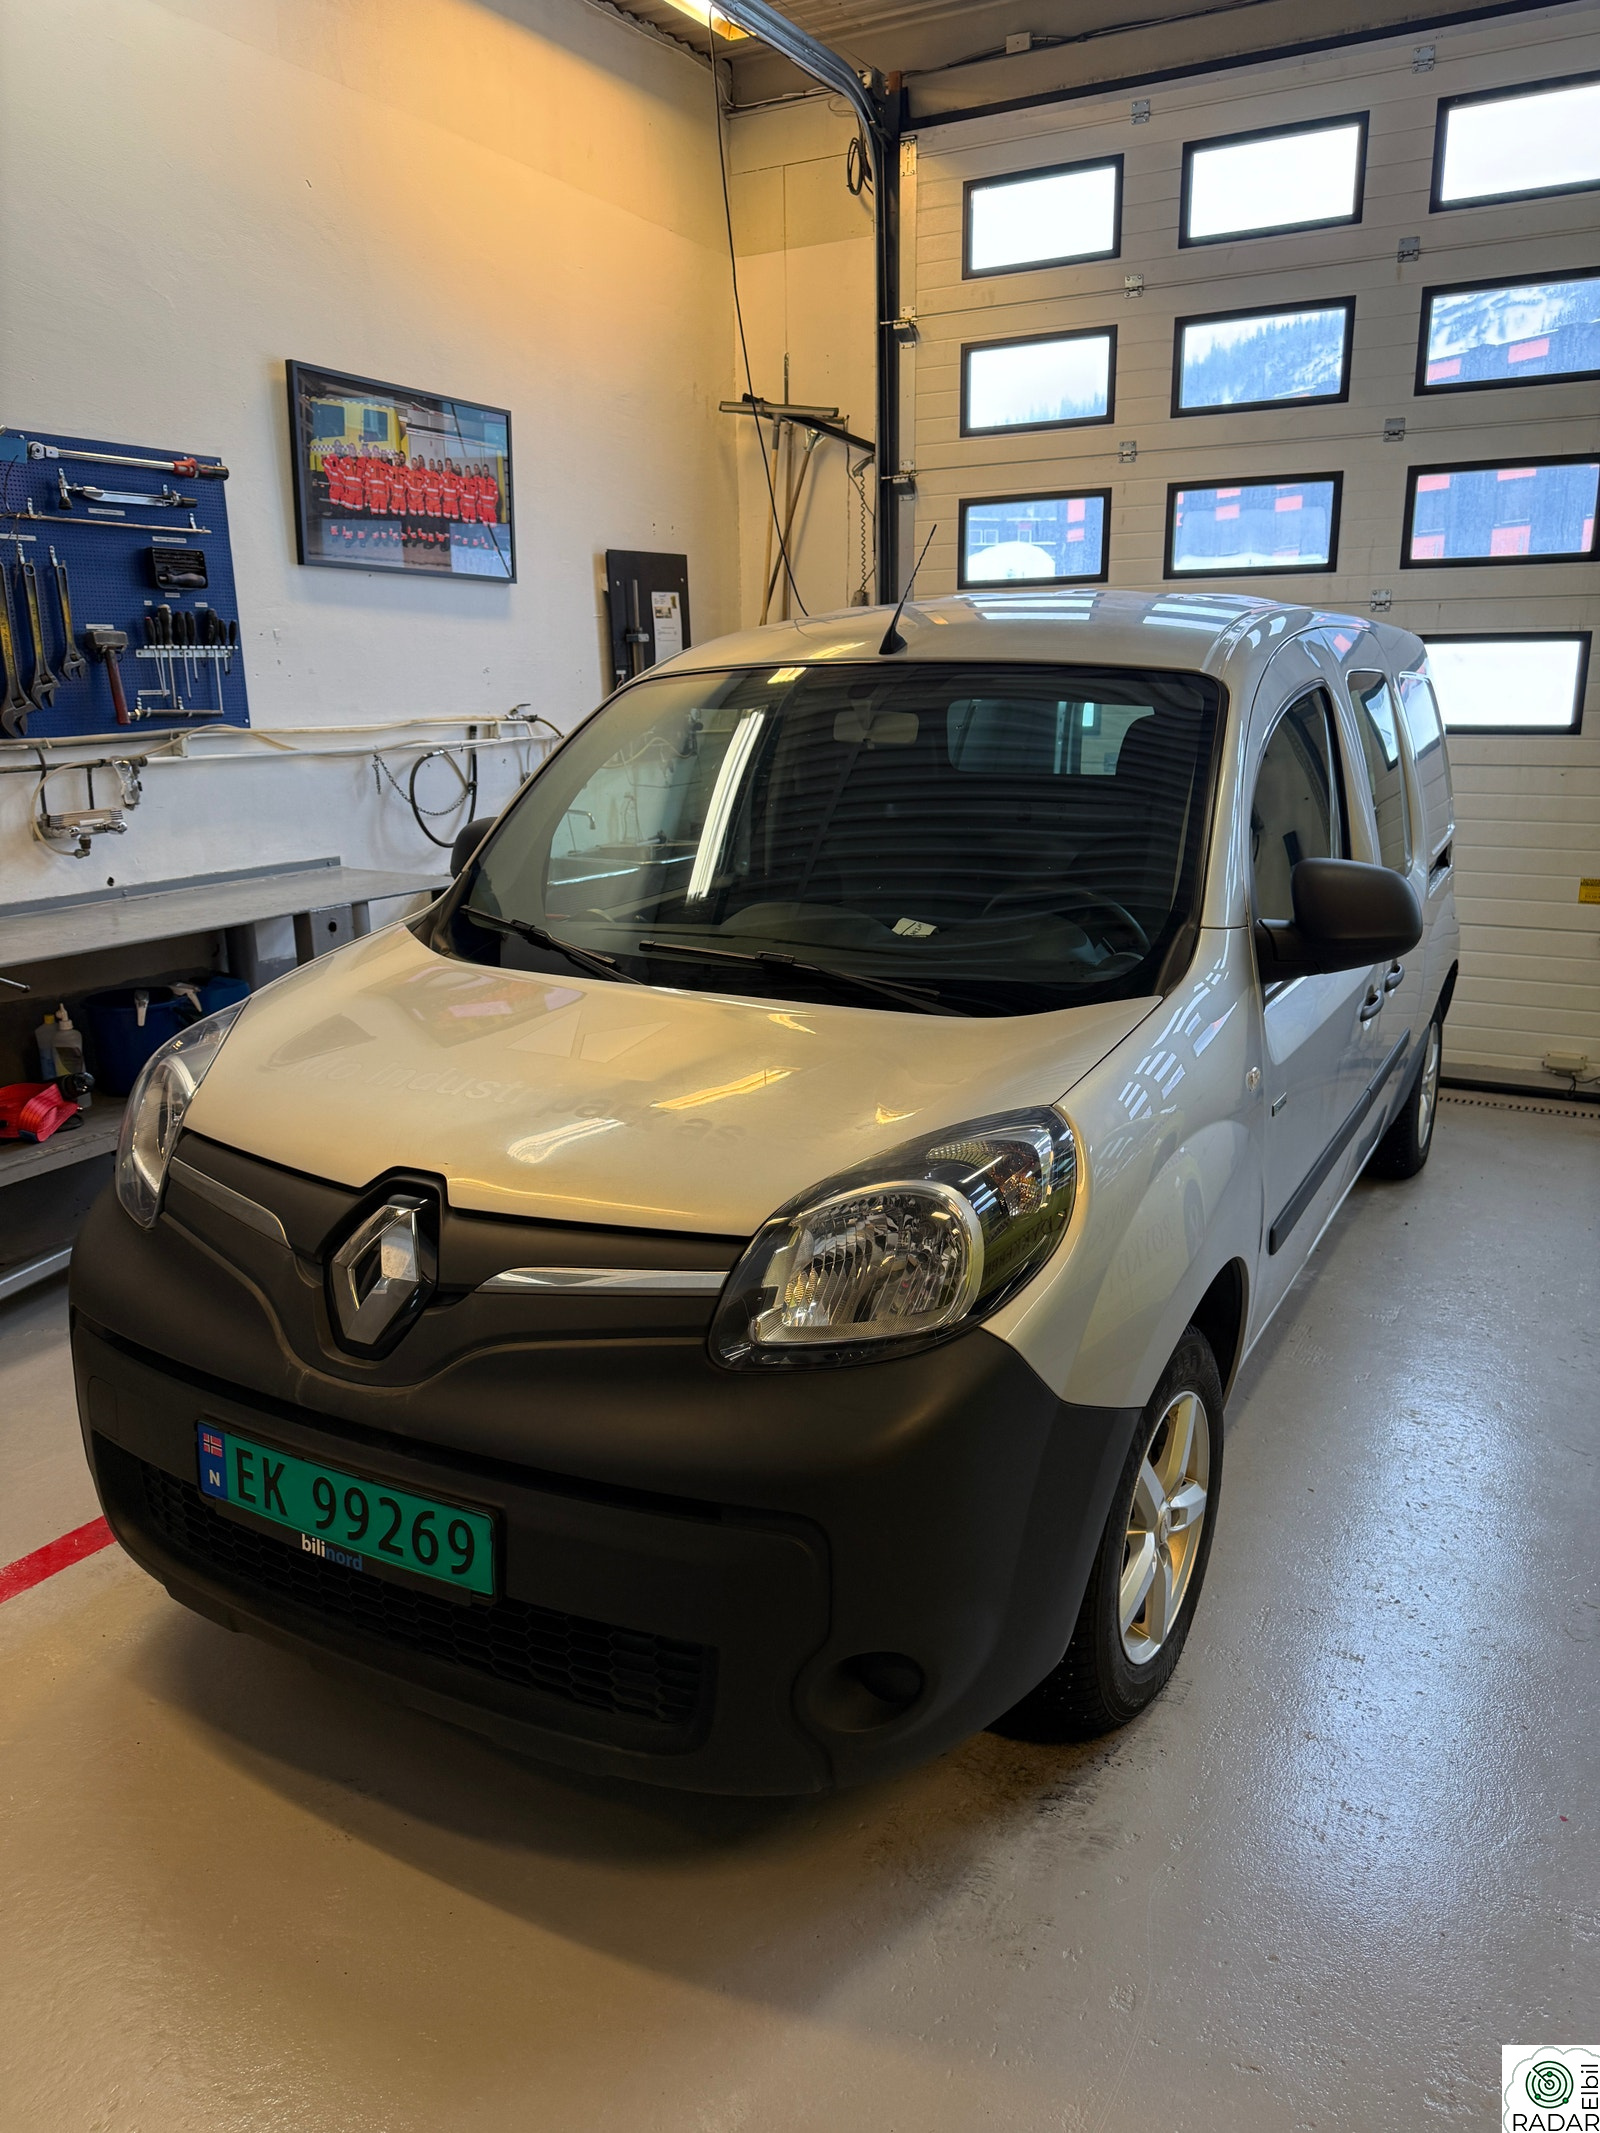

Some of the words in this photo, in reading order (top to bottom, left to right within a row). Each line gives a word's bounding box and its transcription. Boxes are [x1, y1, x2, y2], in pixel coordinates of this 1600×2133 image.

[208, 1469, 221, 1488] N
[235, 1446, 288, 1518] EK
[311, 1475, 477, 1576] 99269
[300, 1532, 364, 1573] bilinord
